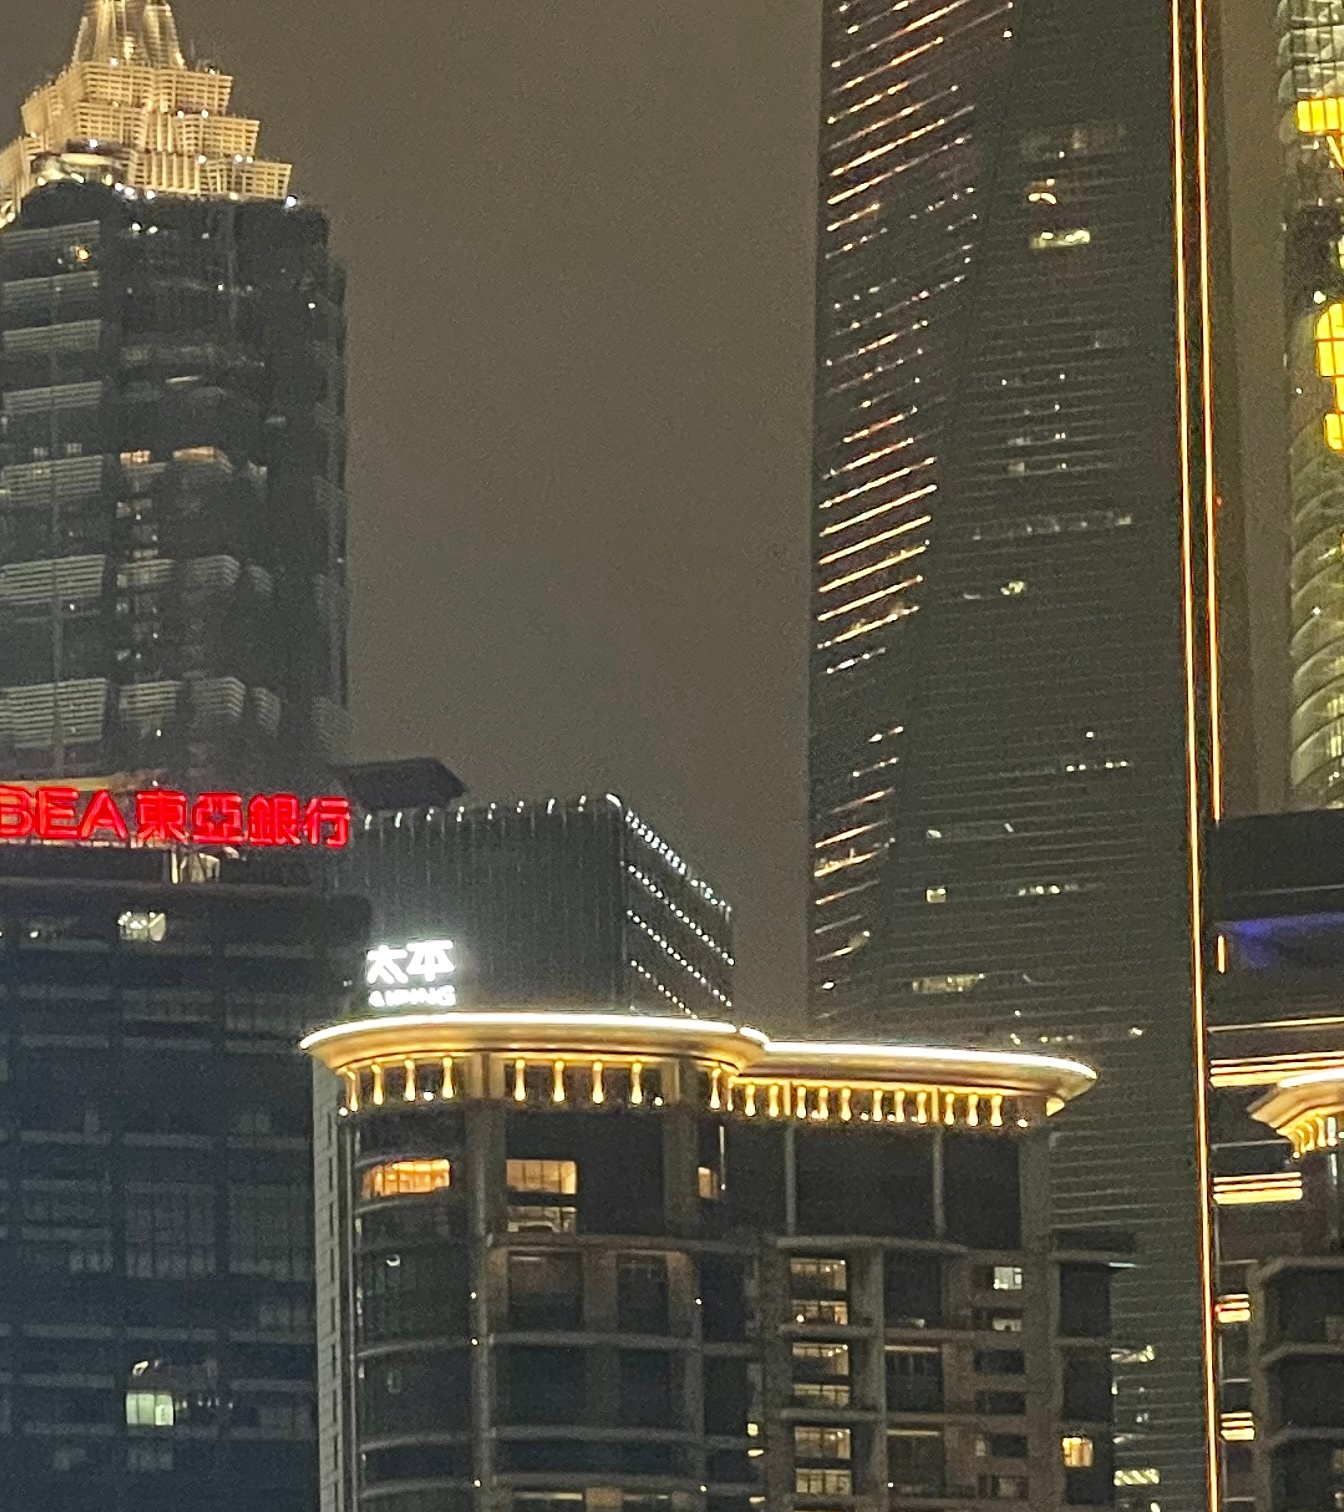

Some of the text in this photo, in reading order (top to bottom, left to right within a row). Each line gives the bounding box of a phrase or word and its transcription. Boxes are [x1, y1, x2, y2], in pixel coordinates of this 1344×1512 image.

[134, 788, 352, 849] 東亞銀行
[366, 939, 456, 985] 太平
